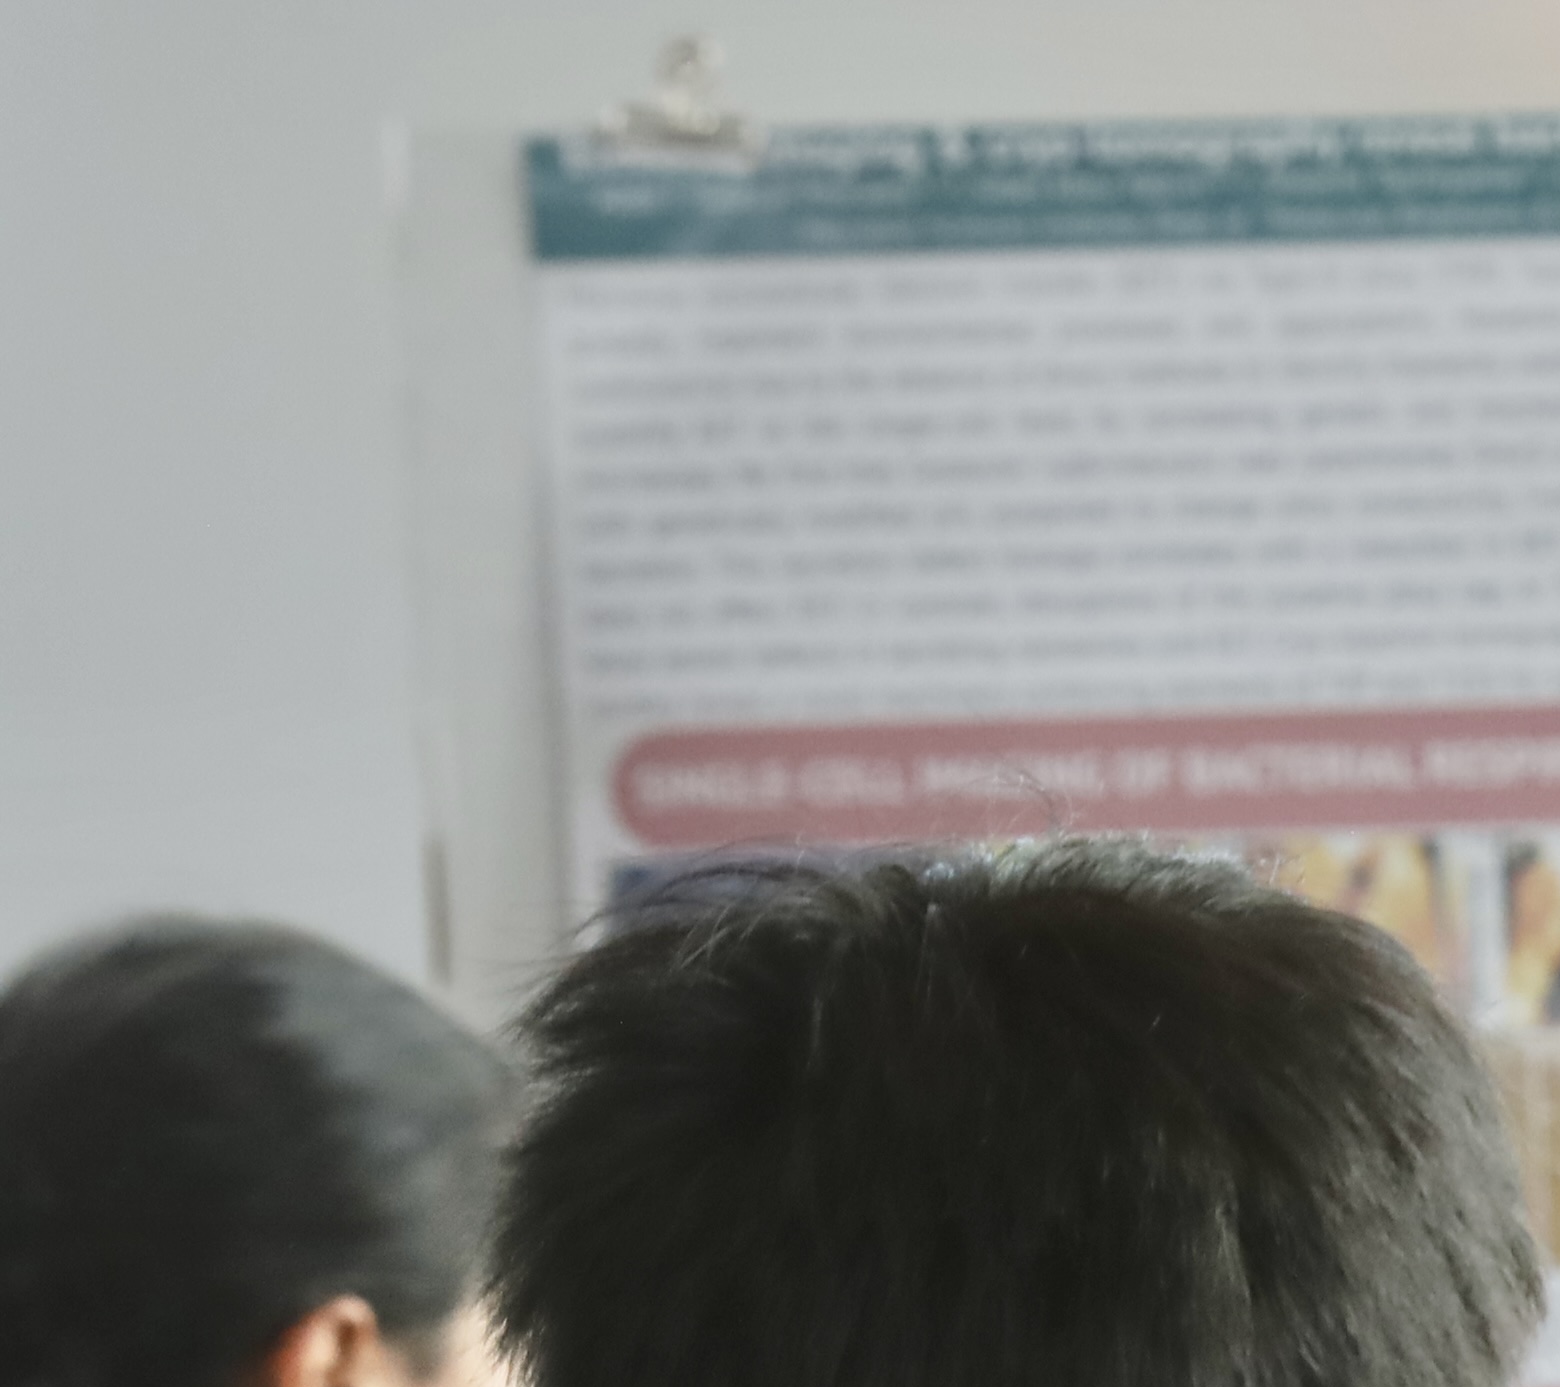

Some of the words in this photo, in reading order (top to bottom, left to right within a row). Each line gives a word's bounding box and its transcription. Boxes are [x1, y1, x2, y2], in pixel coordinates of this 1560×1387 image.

[634, 760, 787, 810] SINGLE
[1118, 746, 1172, 792] OF
[1182, 741, 1413, 792] BACTERIAL
